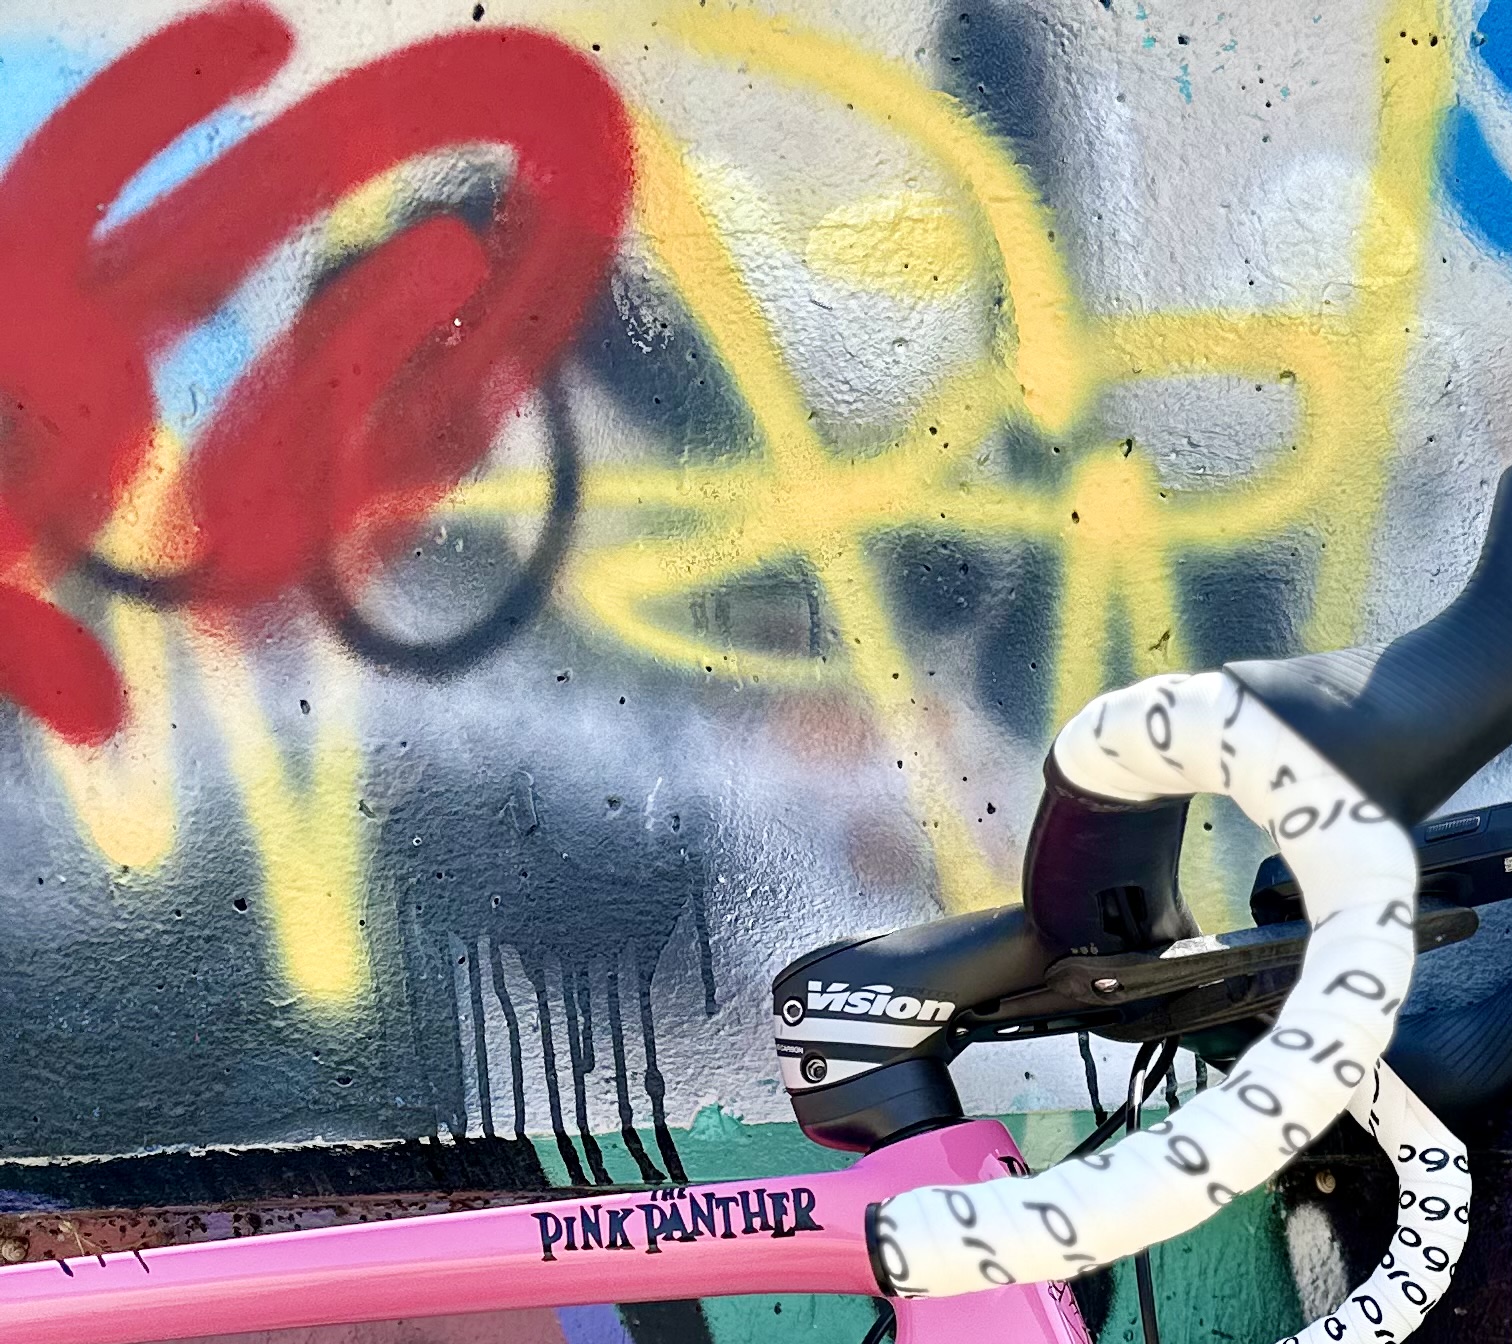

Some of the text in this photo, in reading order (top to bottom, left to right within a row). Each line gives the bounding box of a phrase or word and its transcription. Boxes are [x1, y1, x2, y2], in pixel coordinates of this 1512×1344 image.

[807, 980, 956, 1022] Vision
[532, 1204, 636, 1262] PINK
[636, 1187, 825, 1254] PANTHER
